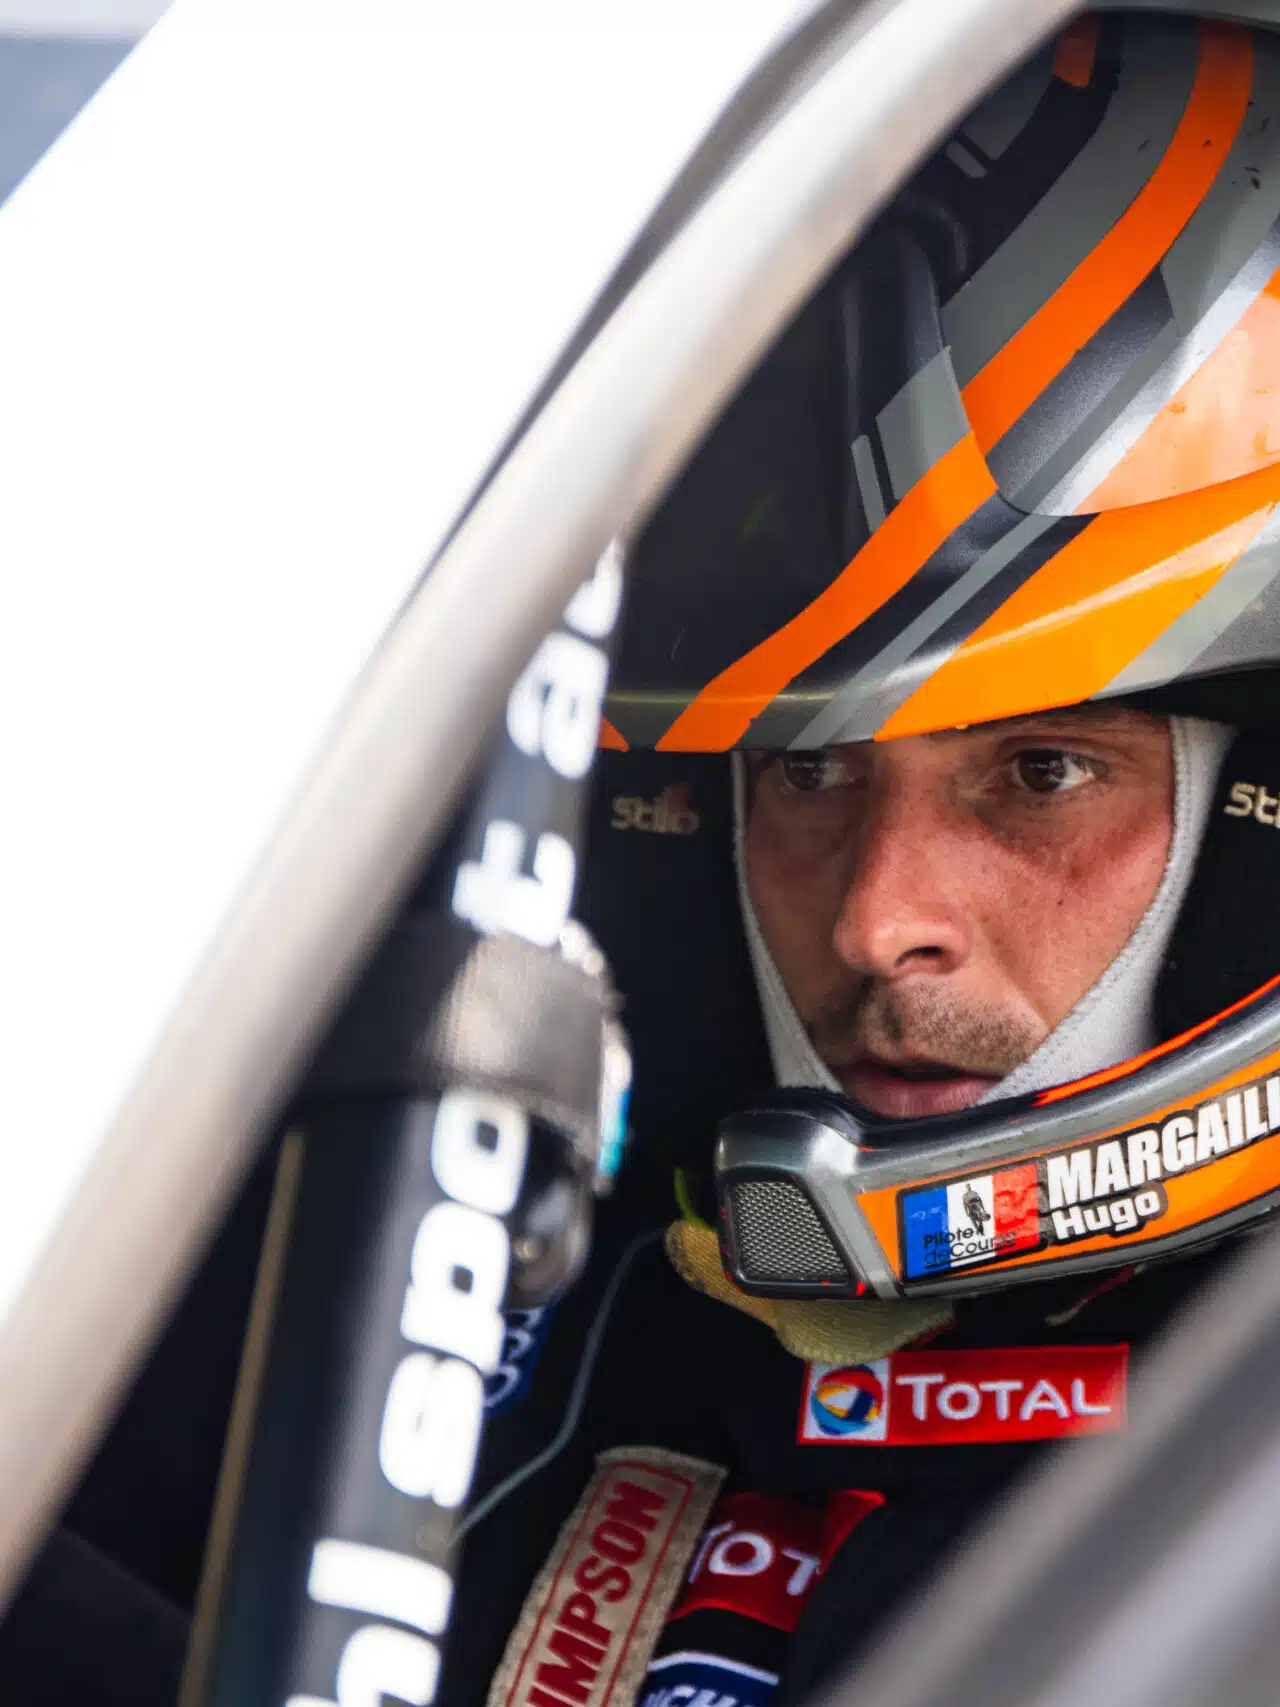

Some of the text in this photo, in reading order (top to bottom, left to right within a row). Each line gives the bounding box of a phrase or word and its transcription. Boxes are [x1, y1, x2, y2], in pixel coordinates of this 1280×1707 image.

[610, 786, 700, 835] Stilo
[378, 818, 578, 1509] spot
[923, 1226, 975, 1249] Pilote
[1051, 1187, 1161, 1242] Hugo
[895, 1372, 1113, 1422] TOTAL
